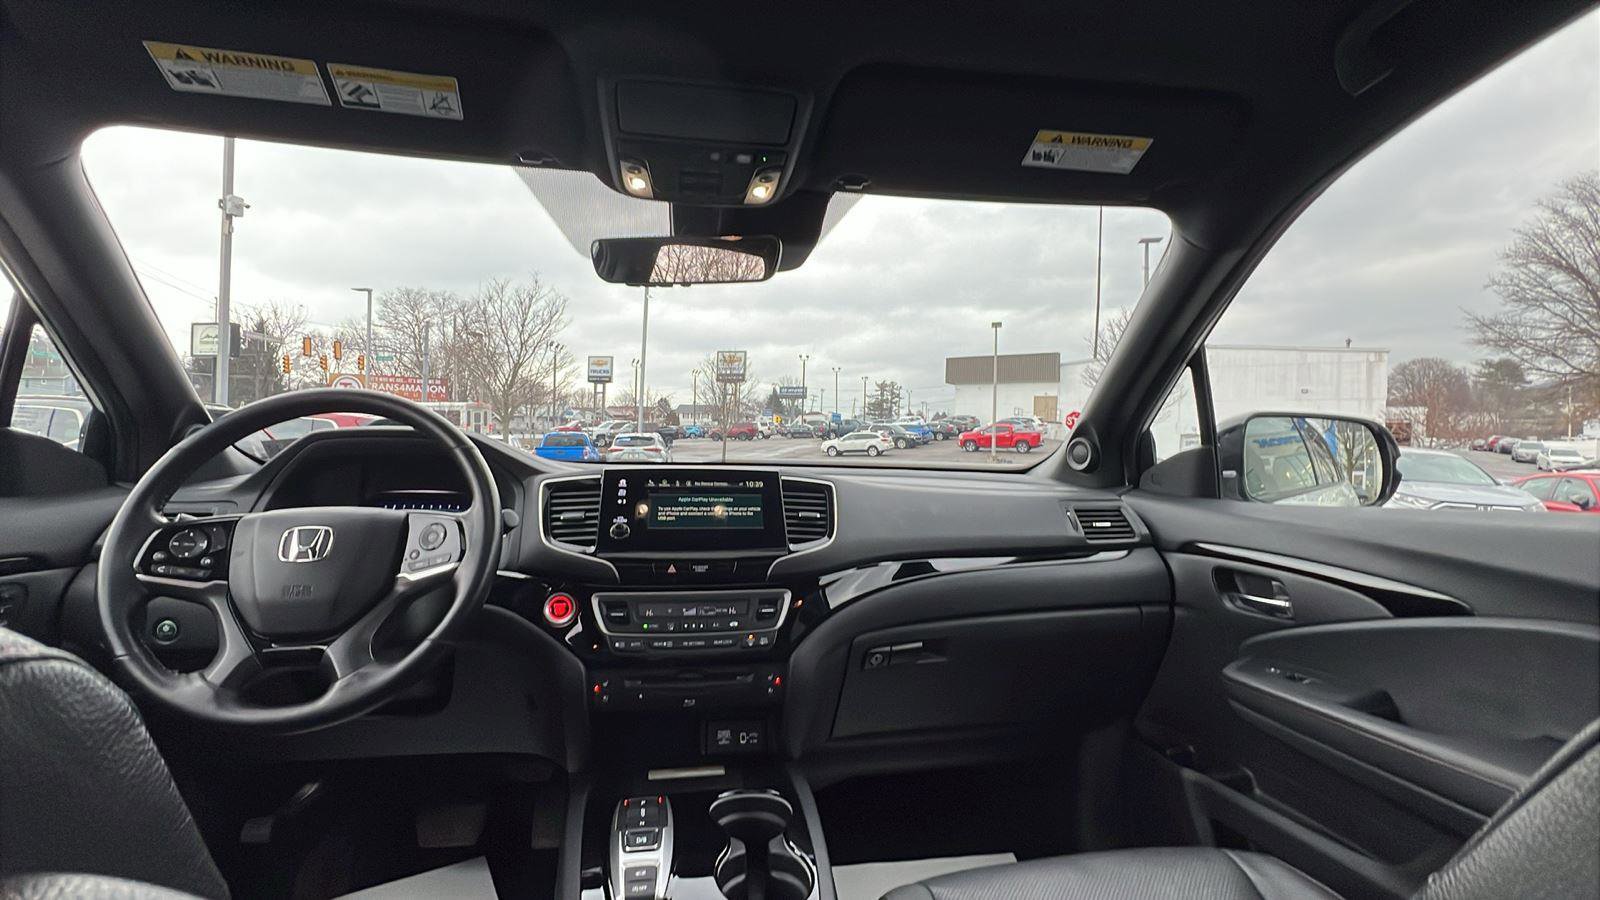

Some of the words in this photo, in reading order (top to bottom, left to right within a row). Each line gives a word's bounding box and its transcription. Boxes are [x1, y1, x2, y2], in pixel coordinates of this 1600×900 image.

[201, 51, 296, 72] WARNING
[1071, 135, 1133, 148] WARNING
[369, 382, 447, 394] RANS4MAION
[745, 480, 764, 488] 10:39
